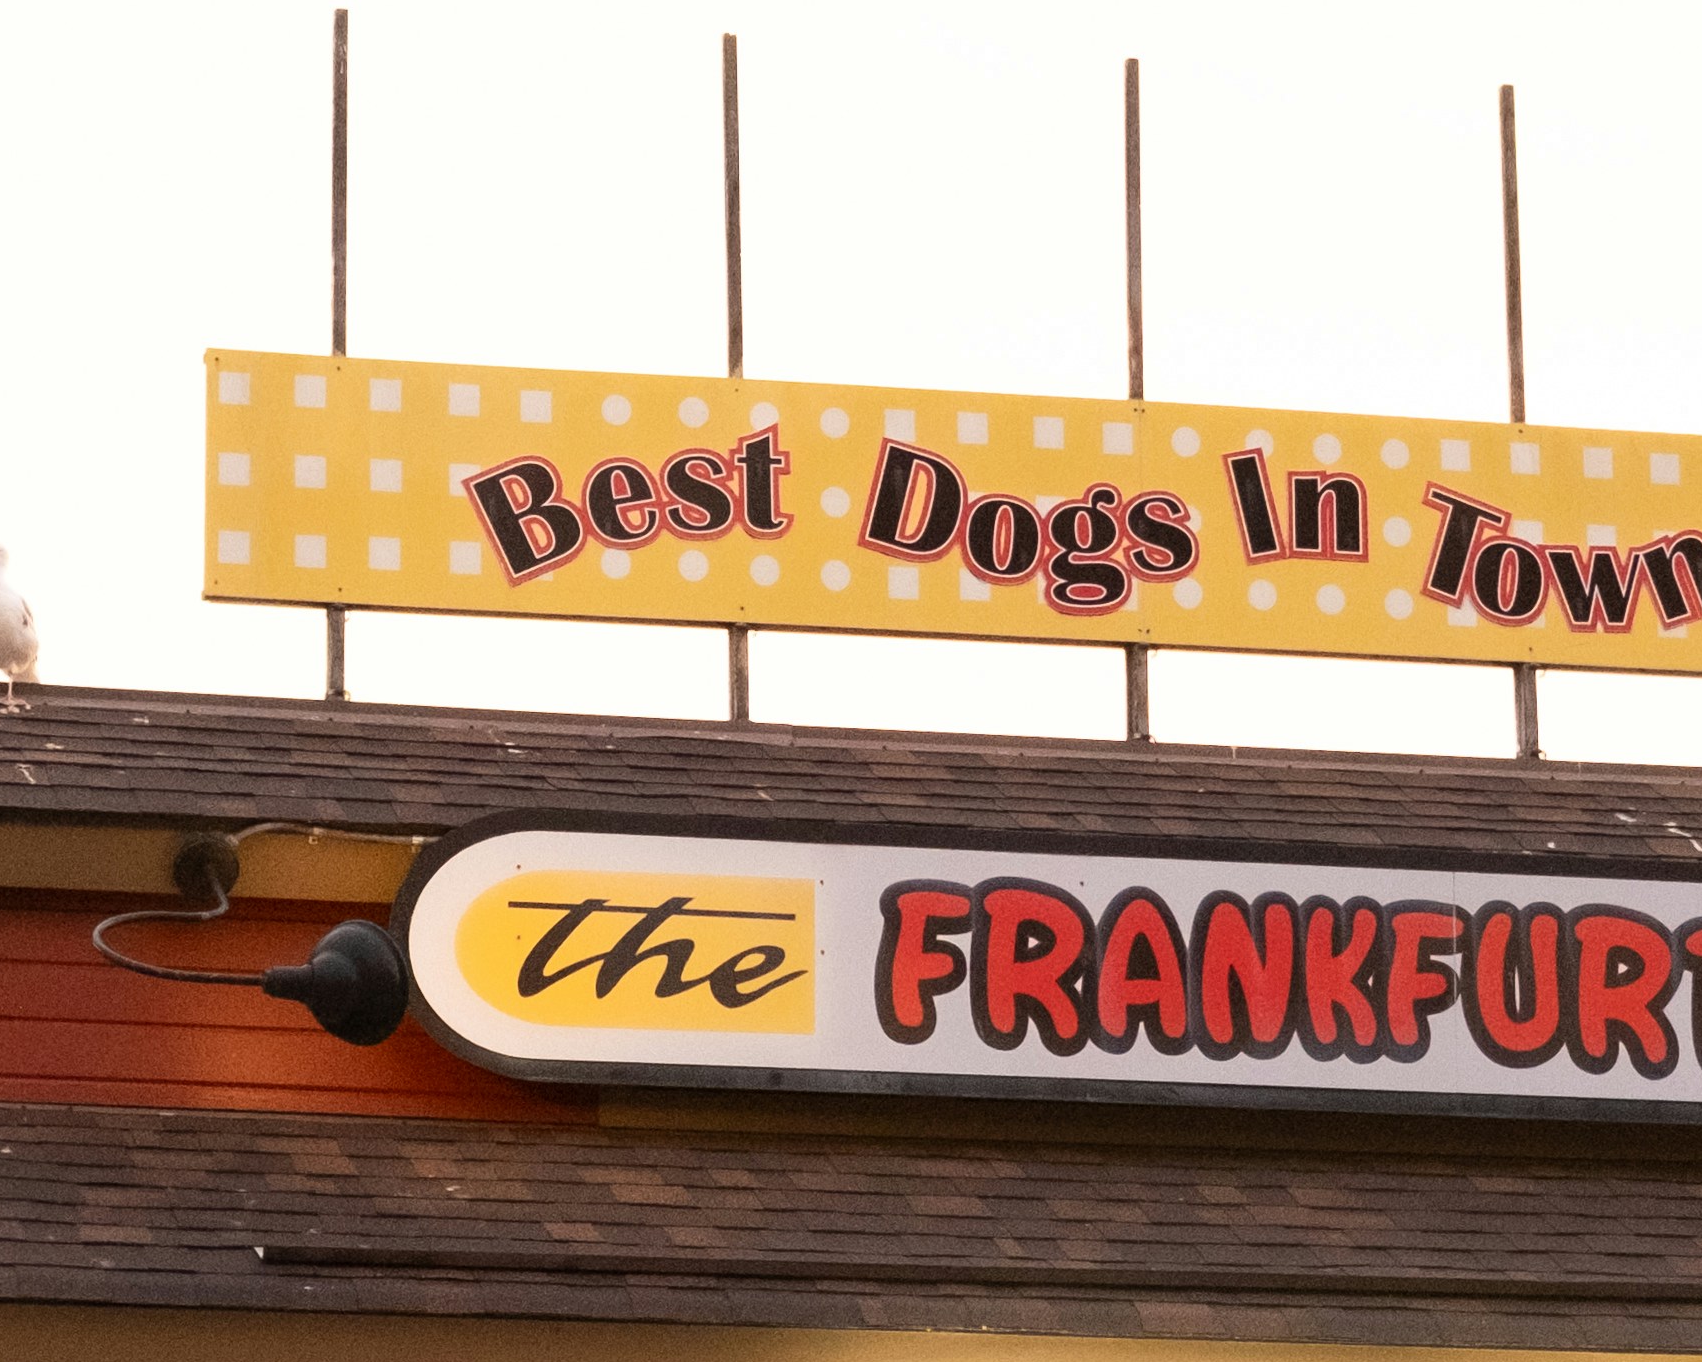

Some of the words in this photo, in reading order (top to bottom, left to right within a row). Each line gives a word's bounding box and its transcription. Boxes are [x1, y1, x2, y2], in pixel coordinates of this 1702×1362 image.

[462, 423, 795, 588] Best
[857, 438, 1200, 616] Dogs
[1222, 448, 1369, 566] In
[508, 896, 808, 1009] the
